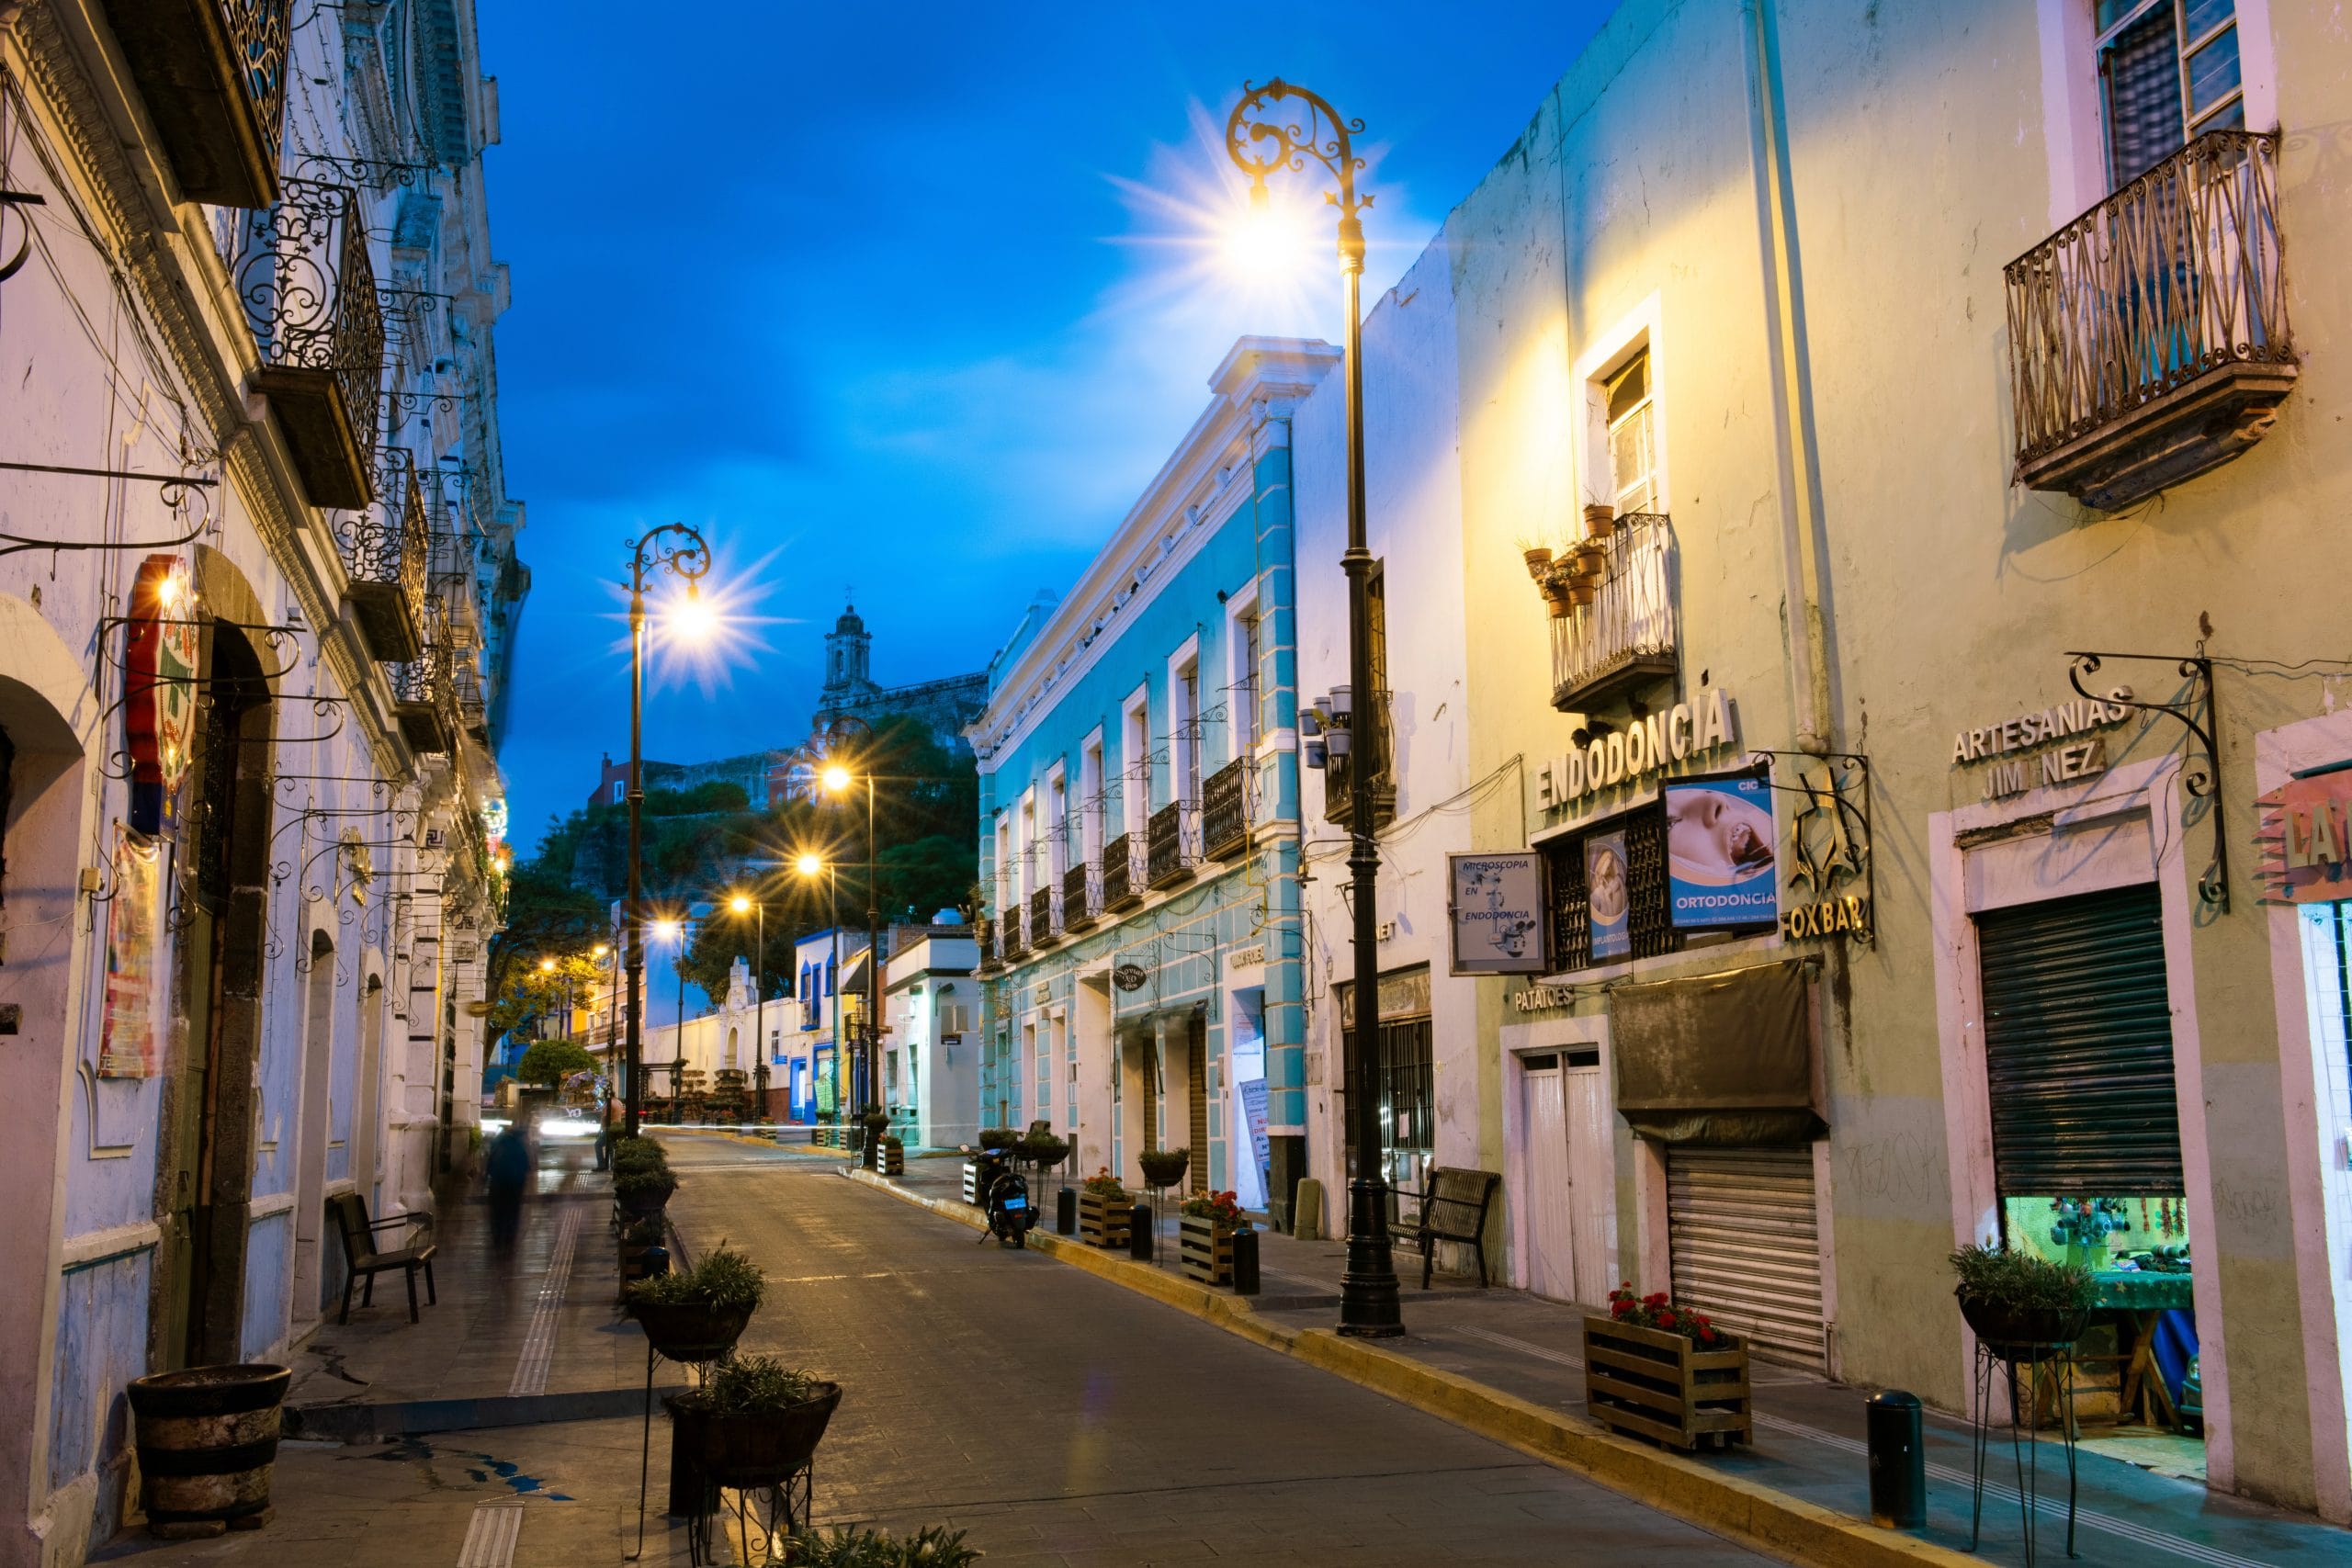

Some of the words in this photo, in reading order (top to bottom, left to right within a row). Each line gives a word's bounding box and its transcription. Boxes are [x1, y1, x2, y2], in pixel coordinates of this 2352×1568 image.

[1951, 686, 2132, 764] ARTESANIAS
[1535, 688, 1735, 812] ENDODONCIA
[1463, 860, 1529, 871] MICROSCOPIA
[1464, 887, 1478, 896] EN
[1676, 892, 1777, 908] ORTODONCIA
[1464, 910, 1530, 920] ENDODONCIA
[1822, 896, 1860, 934] BAR
[1515, 985, 1575, 1011] PATATOES
